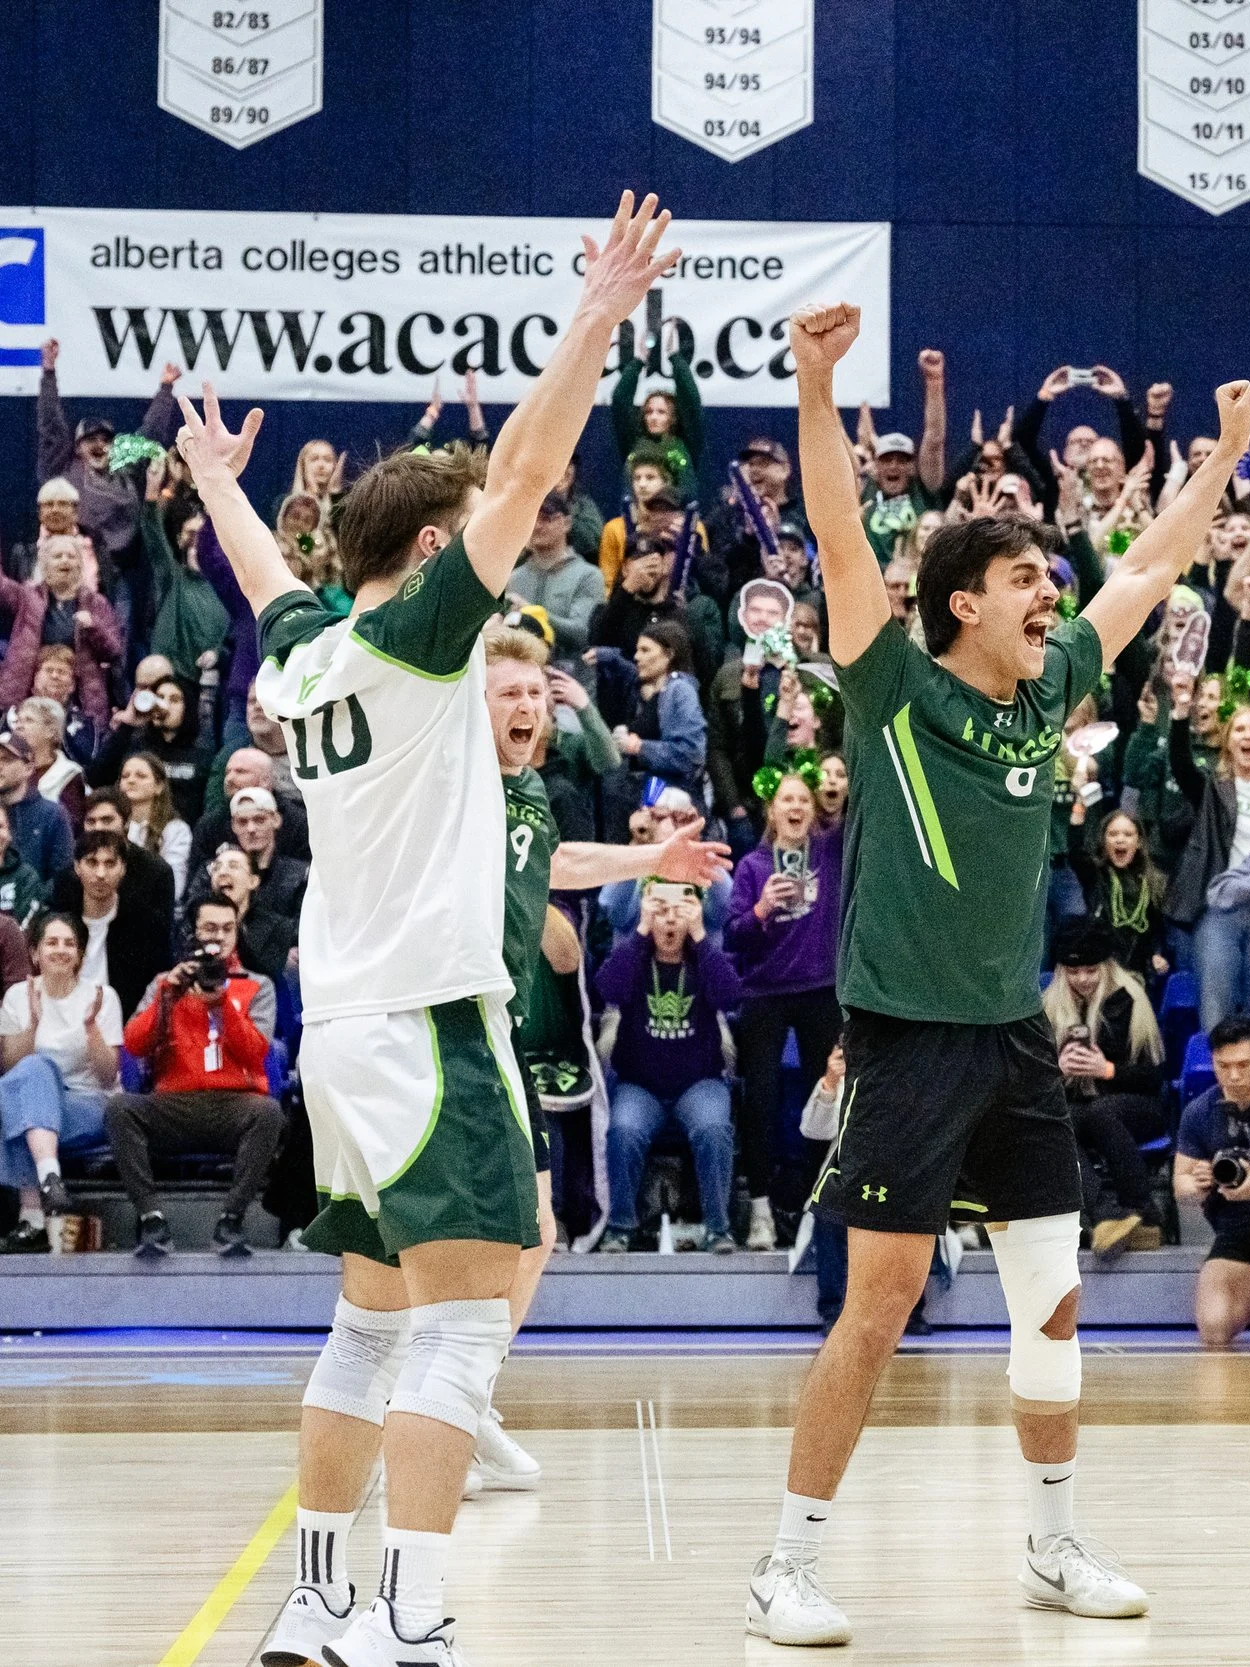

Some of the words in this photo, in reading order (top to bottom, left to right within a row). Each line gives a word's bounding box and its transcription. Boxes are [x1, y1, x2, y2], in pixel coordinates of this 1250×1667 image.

[212, 11, 270, 30] 82/83
[705, 27, 761, 45] 93/94
[1189, 32, 1245, 50] 03/04
[212, 57, 269, 76] 86/87
[704, 73, 761, 91] 94/95
[1189, 77, 1245, 95] 09/10
[210, 106, 270, 125] 89/90
[704, 120, 761, 138] 03/04
[1193, 123, 1244, 140] 10/11
[1189, 172, 1247, 191] 15/16
[91, 237, 222, 269] alberta
[242, 240, 400, 280] colleges
[419, 244, 552, 276] athletic
[566, 251, 784, 280] crence
[277, 692, 373, 779] 10
[509, 823, 534, 872] 9
